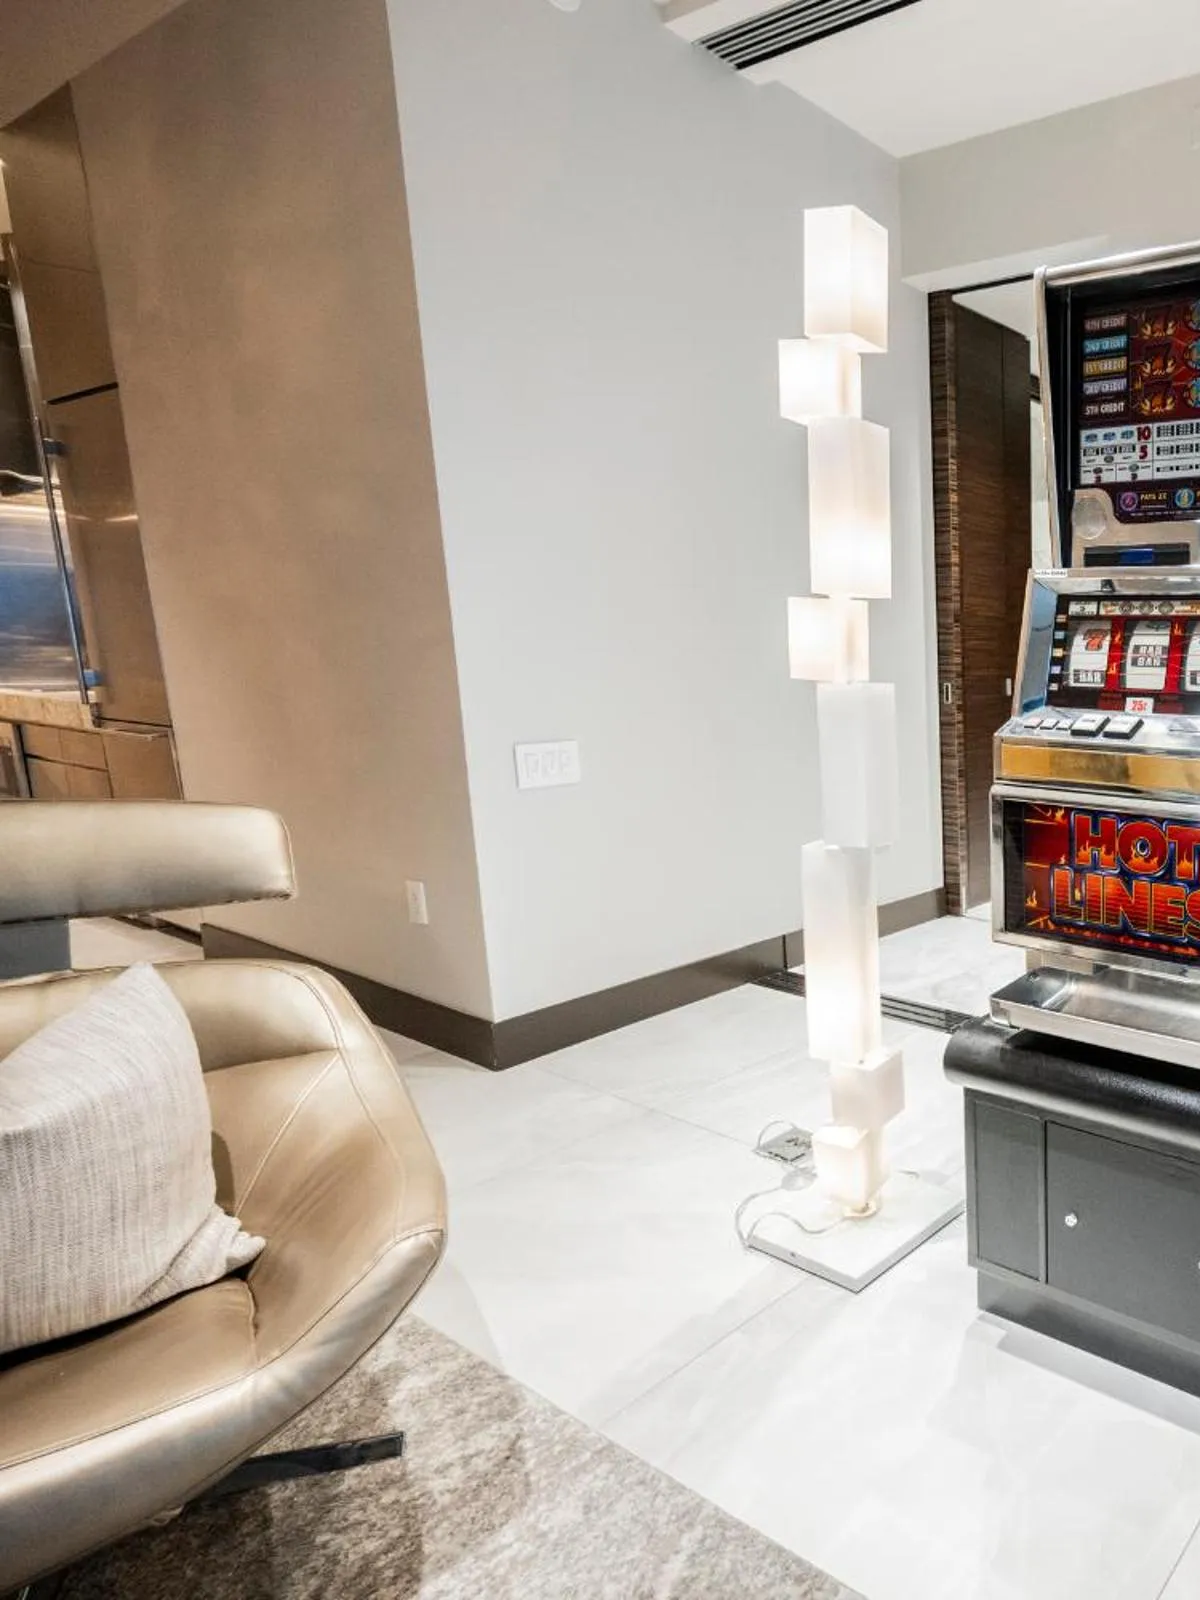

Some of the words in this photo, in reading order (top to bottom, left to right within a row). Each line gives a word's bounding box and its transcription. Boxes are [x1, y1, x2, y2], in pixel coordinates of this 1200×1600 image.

[1101, 313, 1127, 329] CREDIT
[1085, 405, 1099, 415] 5TH
[1100, 402, 1124, 414] CREDIT
[1137, 425, 1151, 442] 10
[1139, 444, 1148, 460] 5
[1139, 645, 1163, 656] BAR
[1137, 656, 1162, 666] BAR
[1079, 671, 1101, 683] BAR
